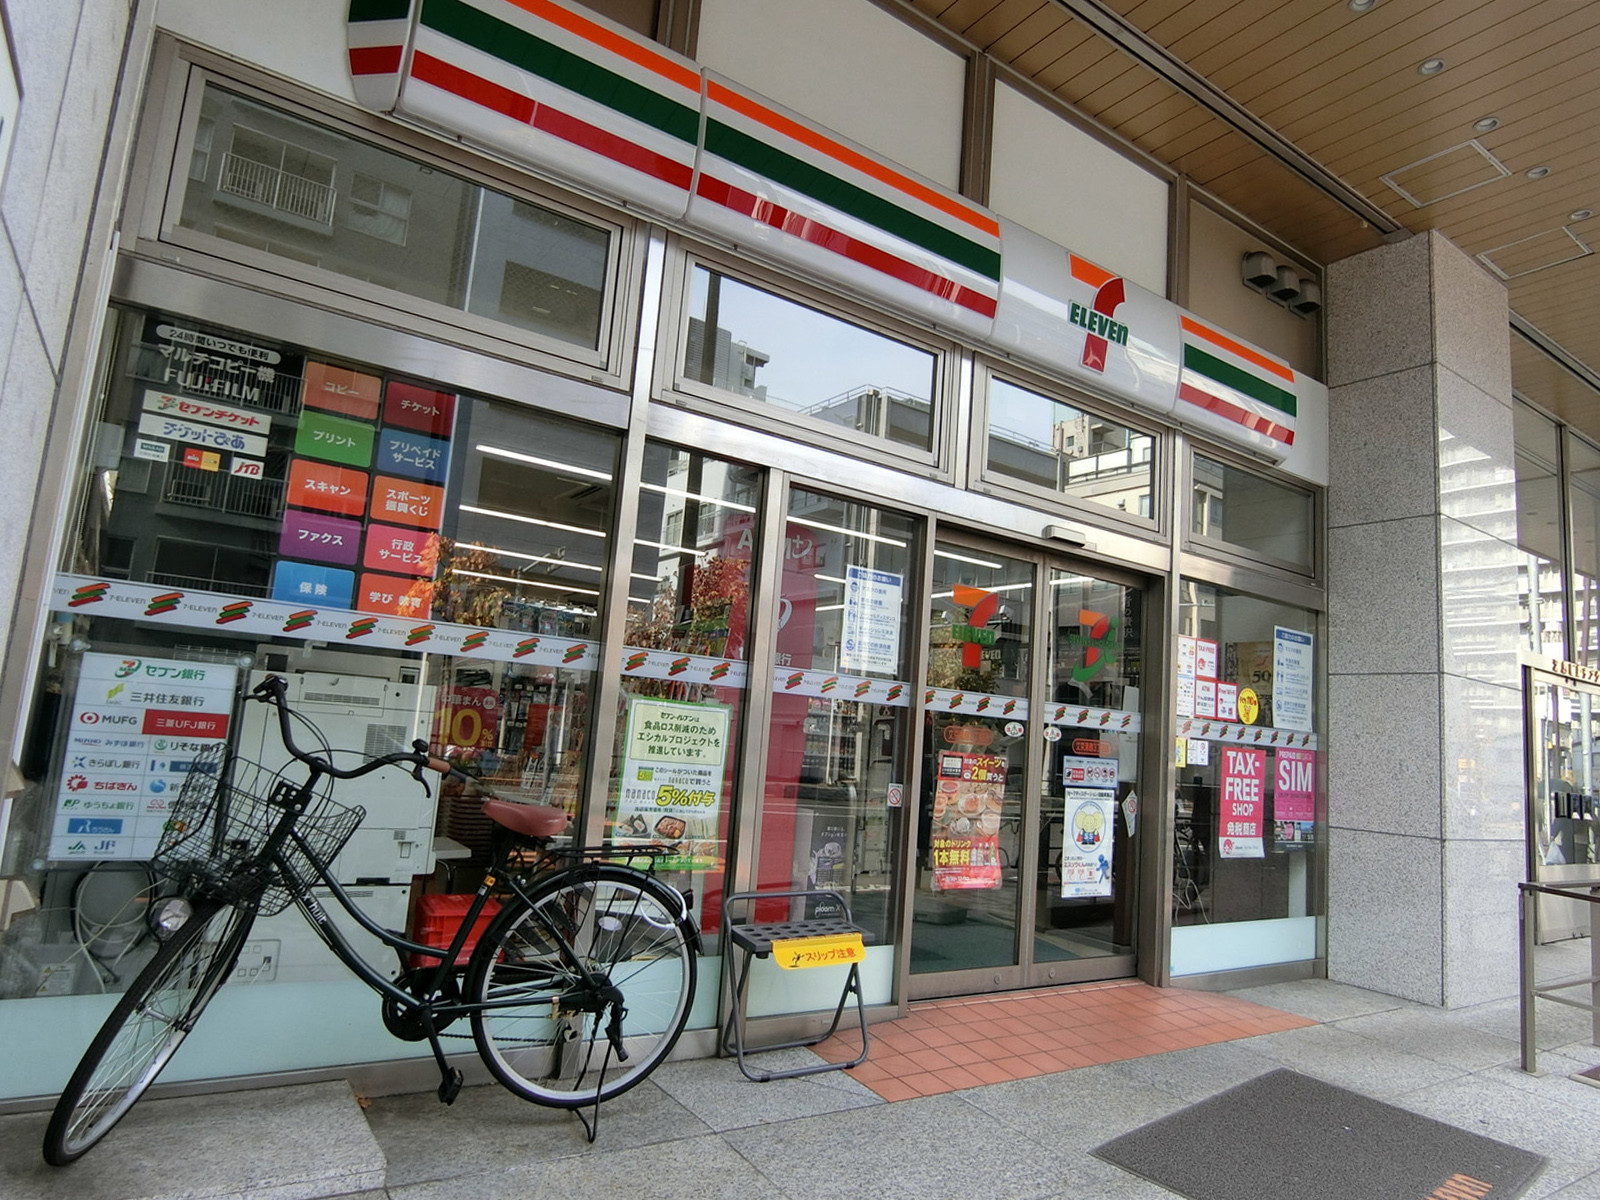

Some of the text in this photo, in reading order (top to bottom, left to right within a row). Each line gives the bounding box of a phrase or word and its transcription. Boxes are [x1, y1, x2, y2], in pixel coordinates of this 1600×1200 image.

[169, 329, 270, 361] 24時間いつでも便利
[158, 344, 275, 383] マルチコピー機
[324, 381, 360, 396] コピー
[178, 401, 260, 426] セブンチケット
[400, 399, 441, 416] チケット
[163, 422, 245, 450] チケットぴあ
[312, 430, 356, 448] プリント
[393, 452, 436, 470] サービス
[304, 478, 351, 495] スキャン
[386, 488, 431, 505] スポーツ
[298, 529, 344, 546] ファクス
[391, 539, 415, 552] 行政
[379, 549, 423, 565] サービス
[299, 581, 328, 596] 保険
[369, 591, 393, 604] 学び
[145, 665, 206, 681] セブン銀行
[1252, 670, 1272, 684] 50
[130, 691, 205, 707] 三井住友銀行
[101, 715, 138, 725] MUFG
[156, 718, 217, 731] 三菱UFJ銀行
[644, 720, 716, 736] 食品ロス削減のため
[637, 732, 721, 748] エシカルプロジェクトを
[88, 757, 141, 770] きらぼし銀行
[1227, 750, 1260, 776] TAX-
[1278, 760, 1313, 792] SIM
[93, 781, 138, 791] ちばぎん
[1225, 777, 1260, 802] FREE
[83, 801, 134, 810] ゆうちょ銀行
[1232, 803, 1254, 816] SHOP
[805, 947, 856, 962] スリップ注意
